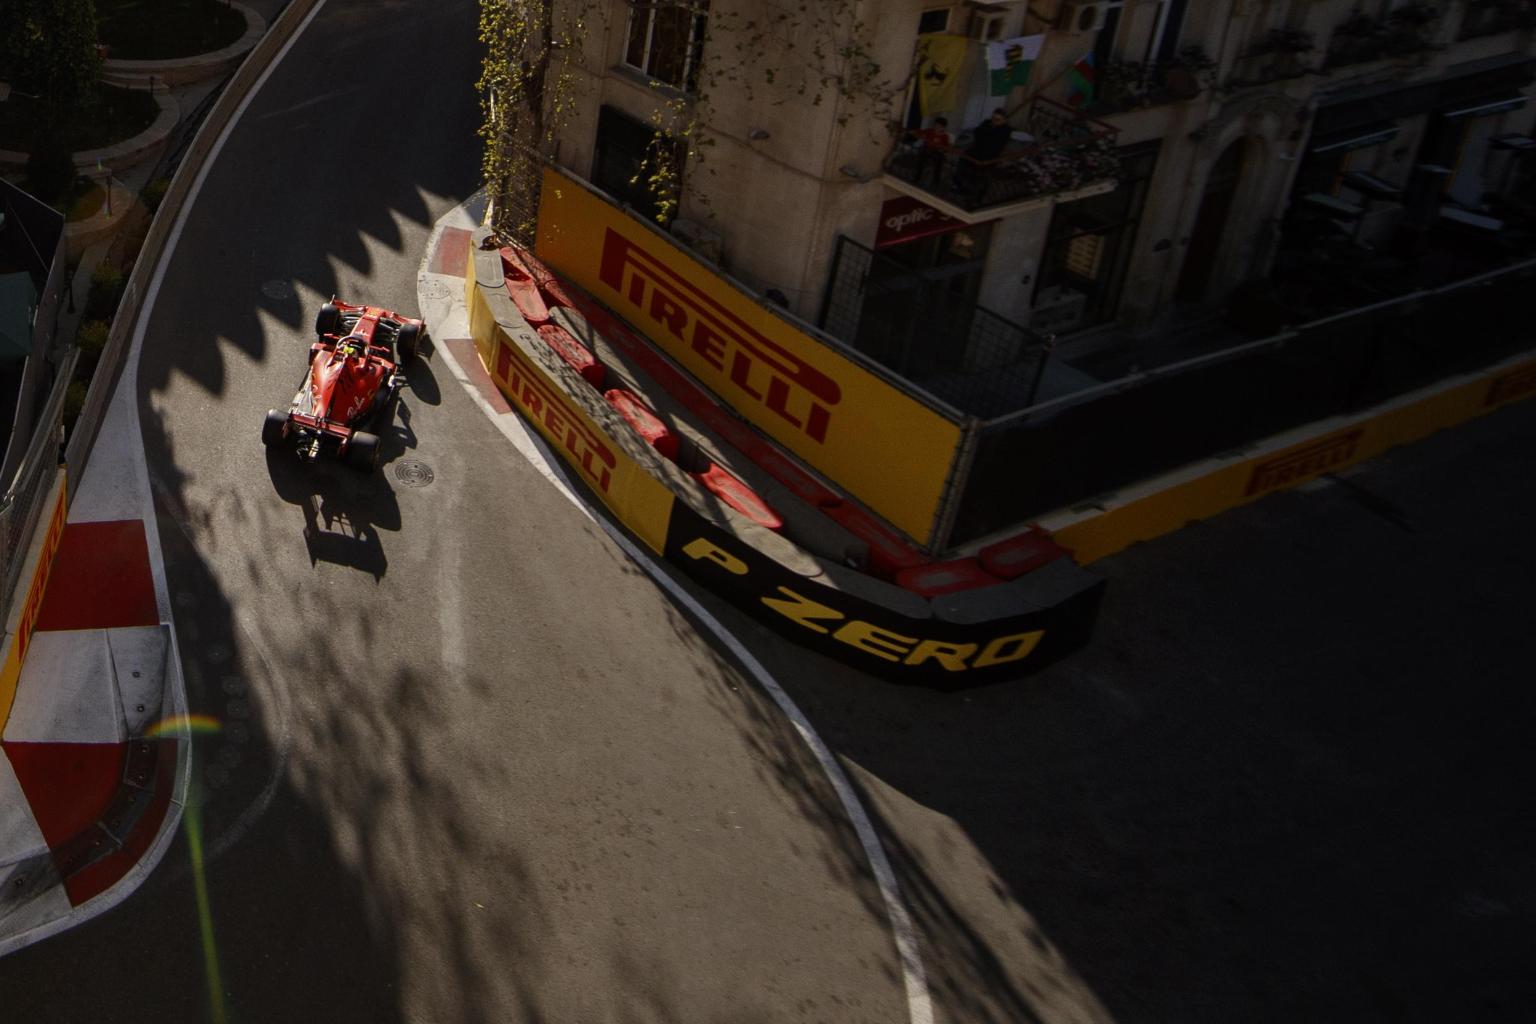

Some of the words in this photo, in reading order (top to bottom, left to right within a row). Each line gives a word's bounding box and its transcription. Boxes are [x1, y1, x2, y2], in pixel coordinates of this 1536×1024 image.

[885, 209, 935, 232] optic
[599, 226, 842, 446] PIRELLI
[497, 340, 617, 494] PIRELLI
[1244, 428, 1365, 496] PIRELLI
[681, 537, 751, 576] P
[760, 584, 1047, 672] ZERO
